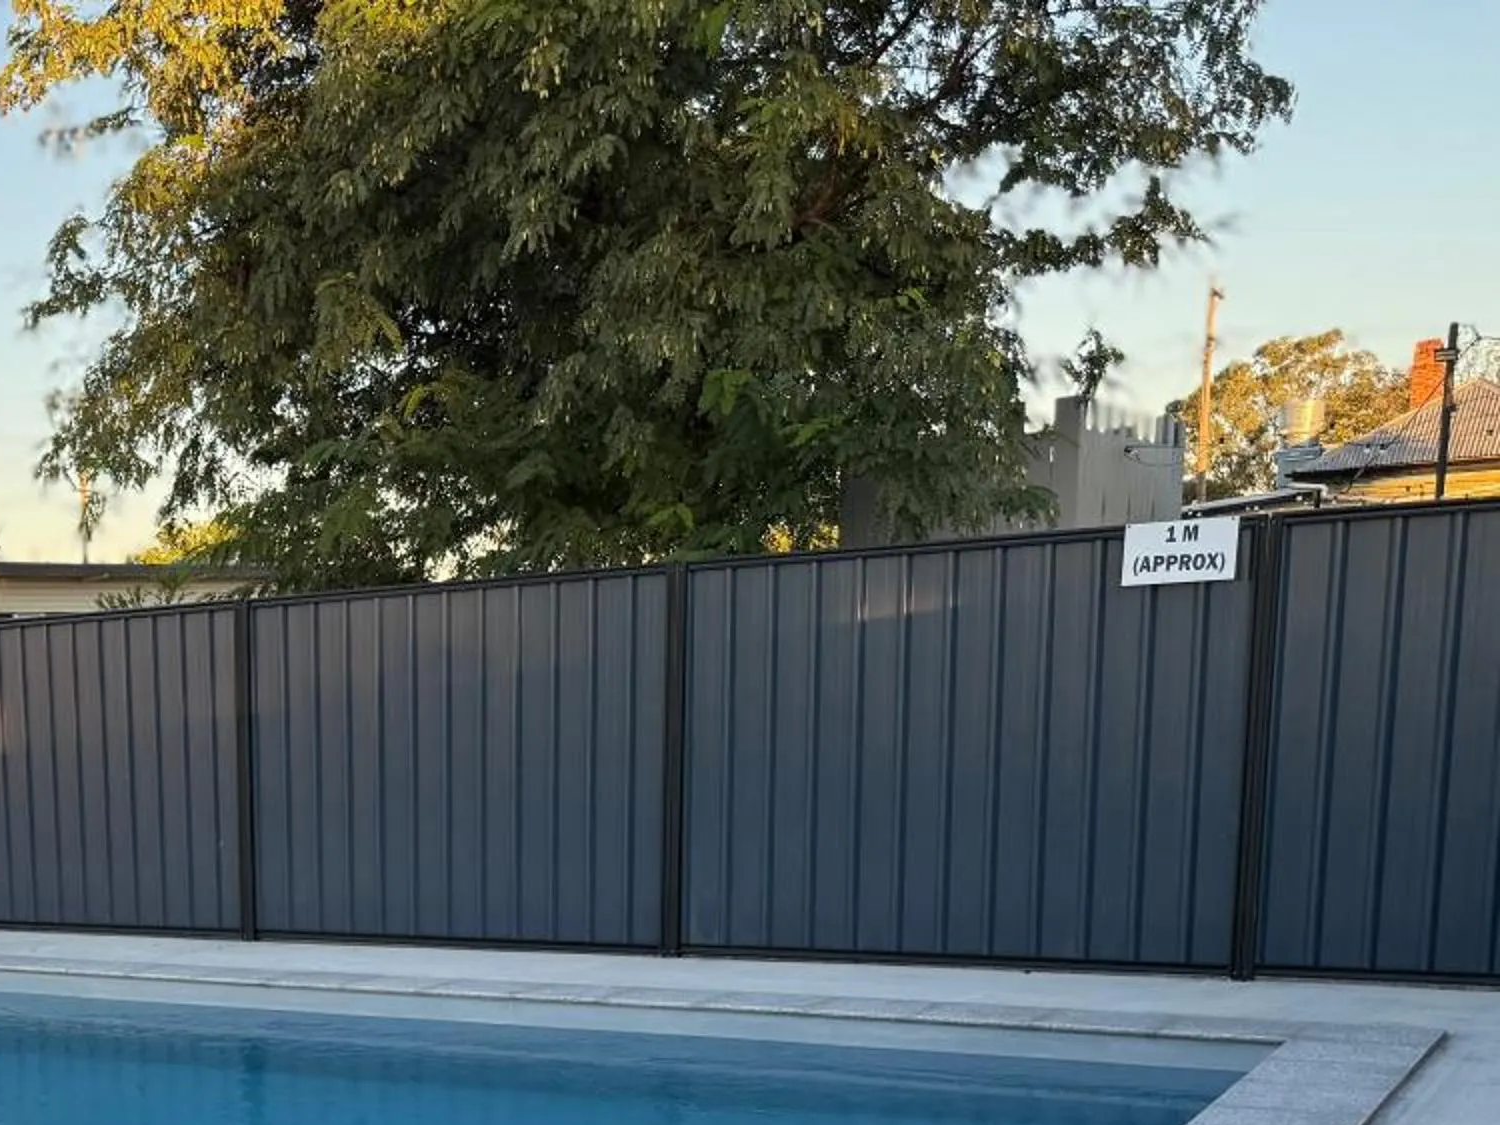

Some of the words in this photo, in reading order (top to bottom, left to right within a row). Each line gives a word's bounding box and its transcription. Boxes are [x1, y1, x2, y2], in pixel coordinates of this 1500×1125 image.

[1165, 524, 1177, 543] 1
[1182, 524, 1200, 543] M
[1133, 552, 1226, 577] (APPROX)
